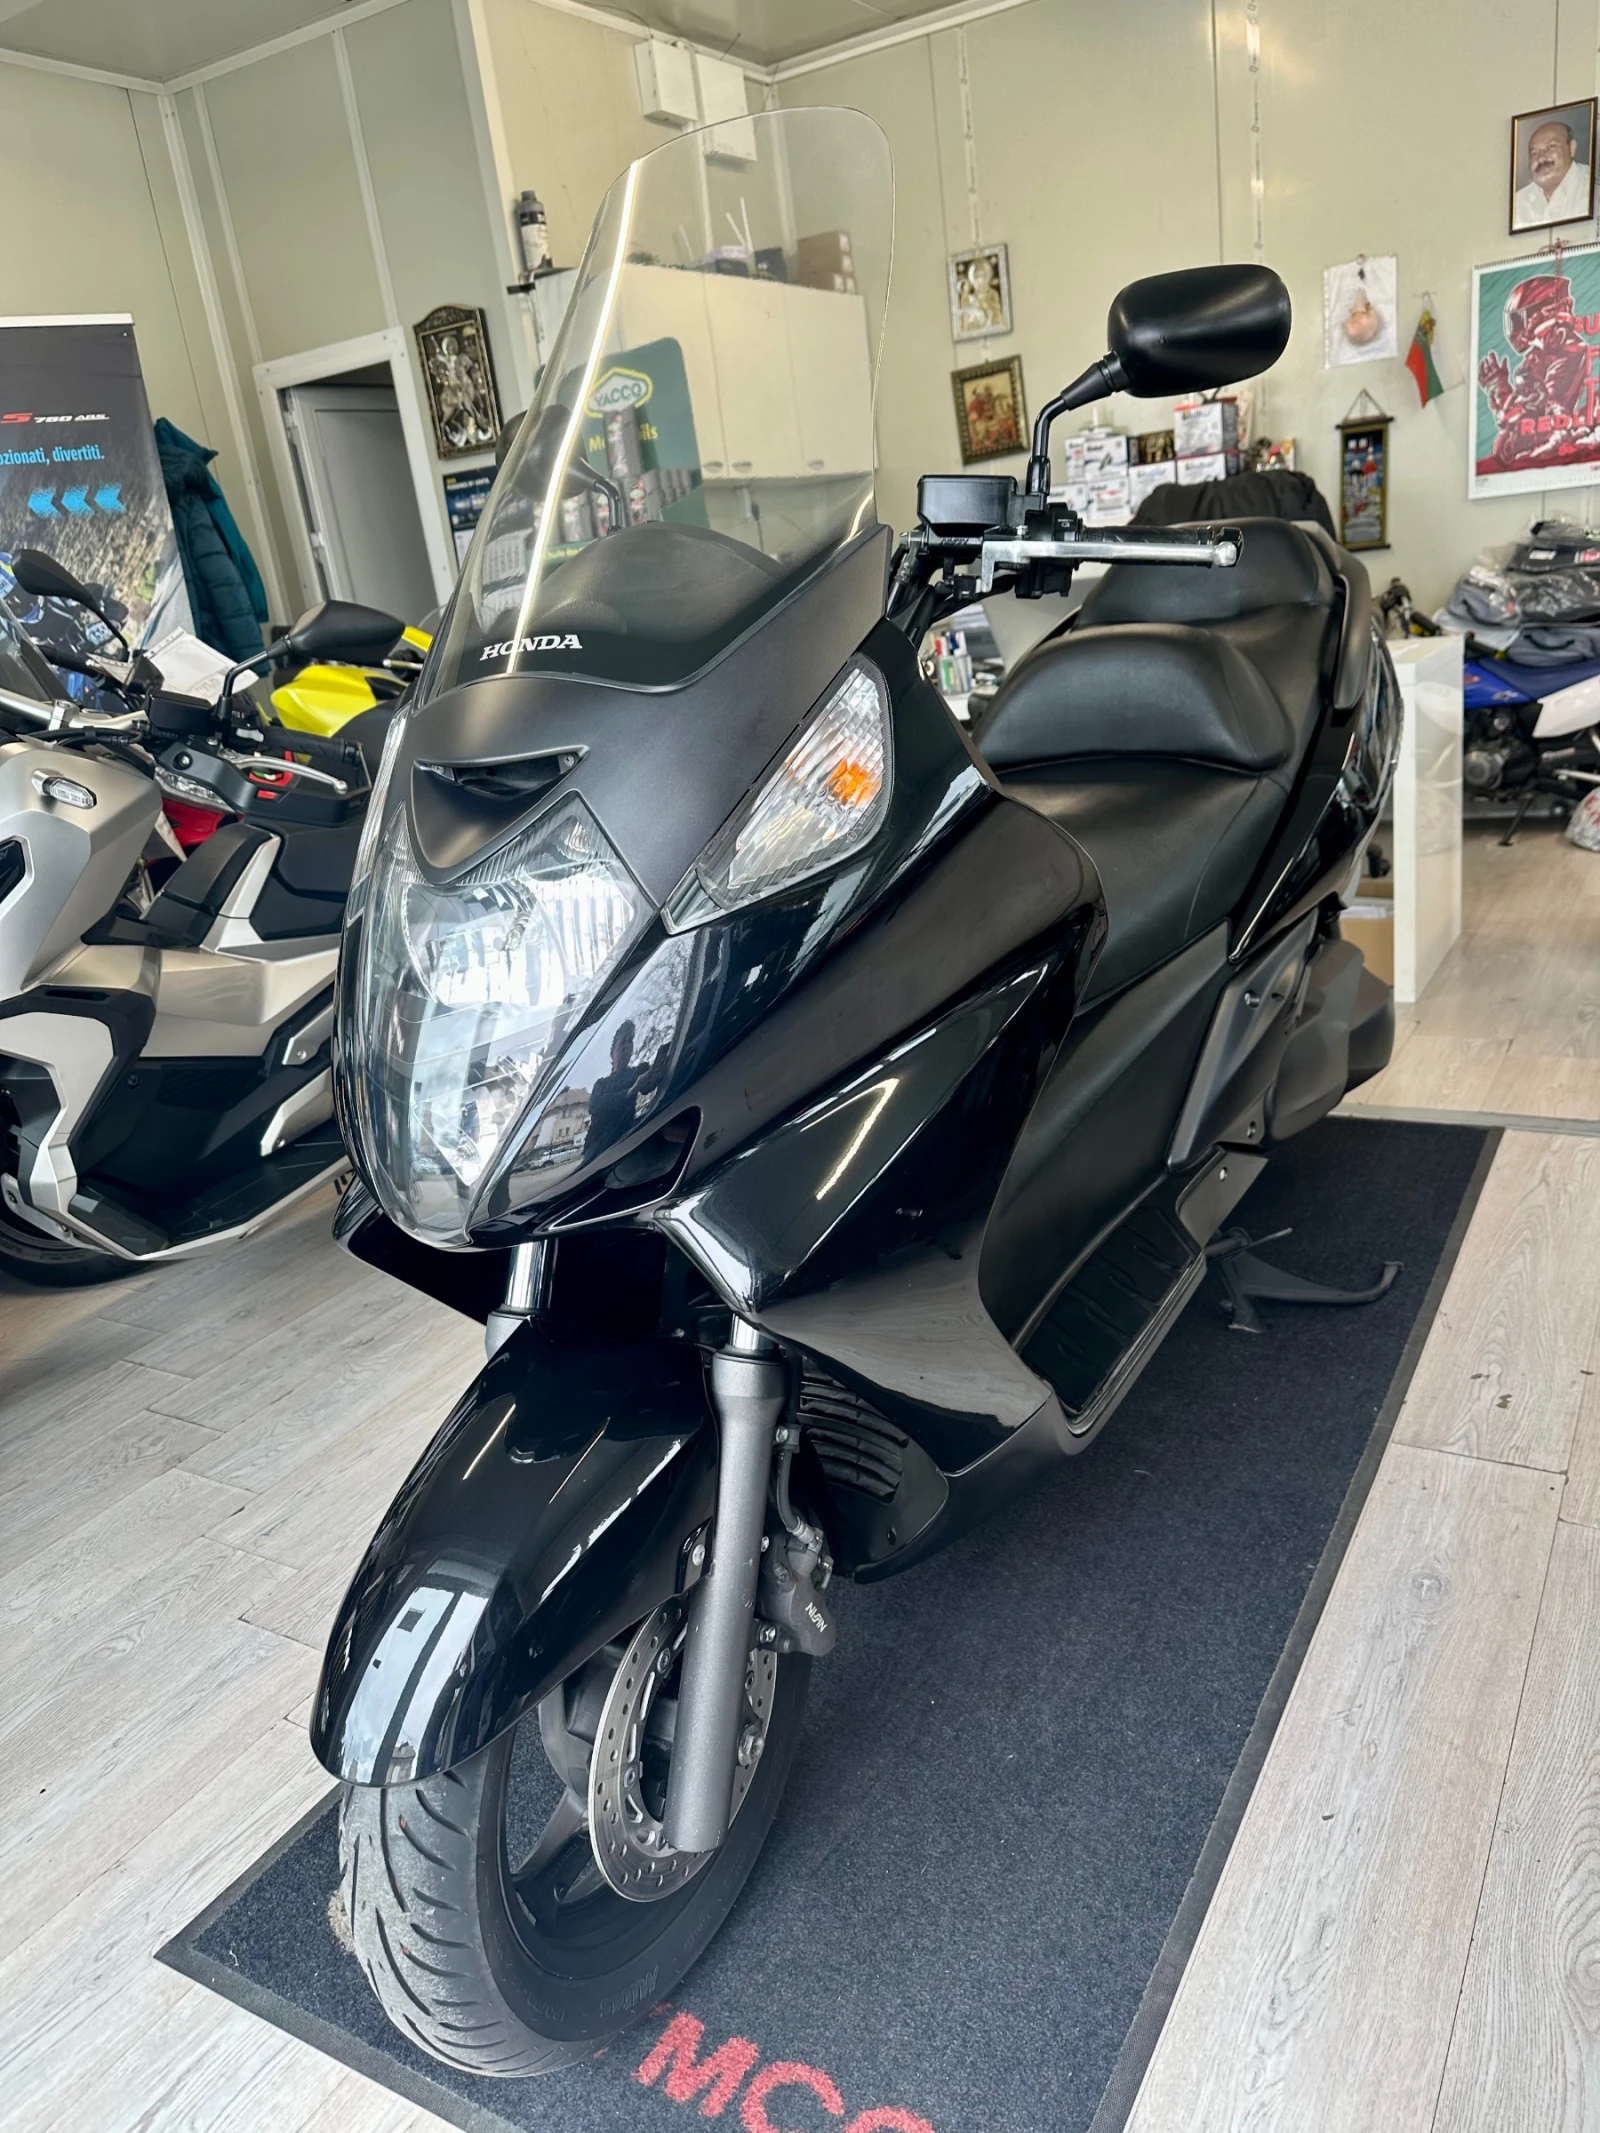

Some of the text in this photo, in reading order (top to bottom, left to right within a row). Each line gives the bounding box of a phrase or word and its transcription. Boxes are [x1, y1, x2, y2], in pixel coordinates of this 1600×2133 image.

[594, 383, 642, 407] YACCO
[52, 444, 105, 462] divertiti.
[479, 634, 583, 661] HONDA
[631, 2011, 937, 2133] MC
